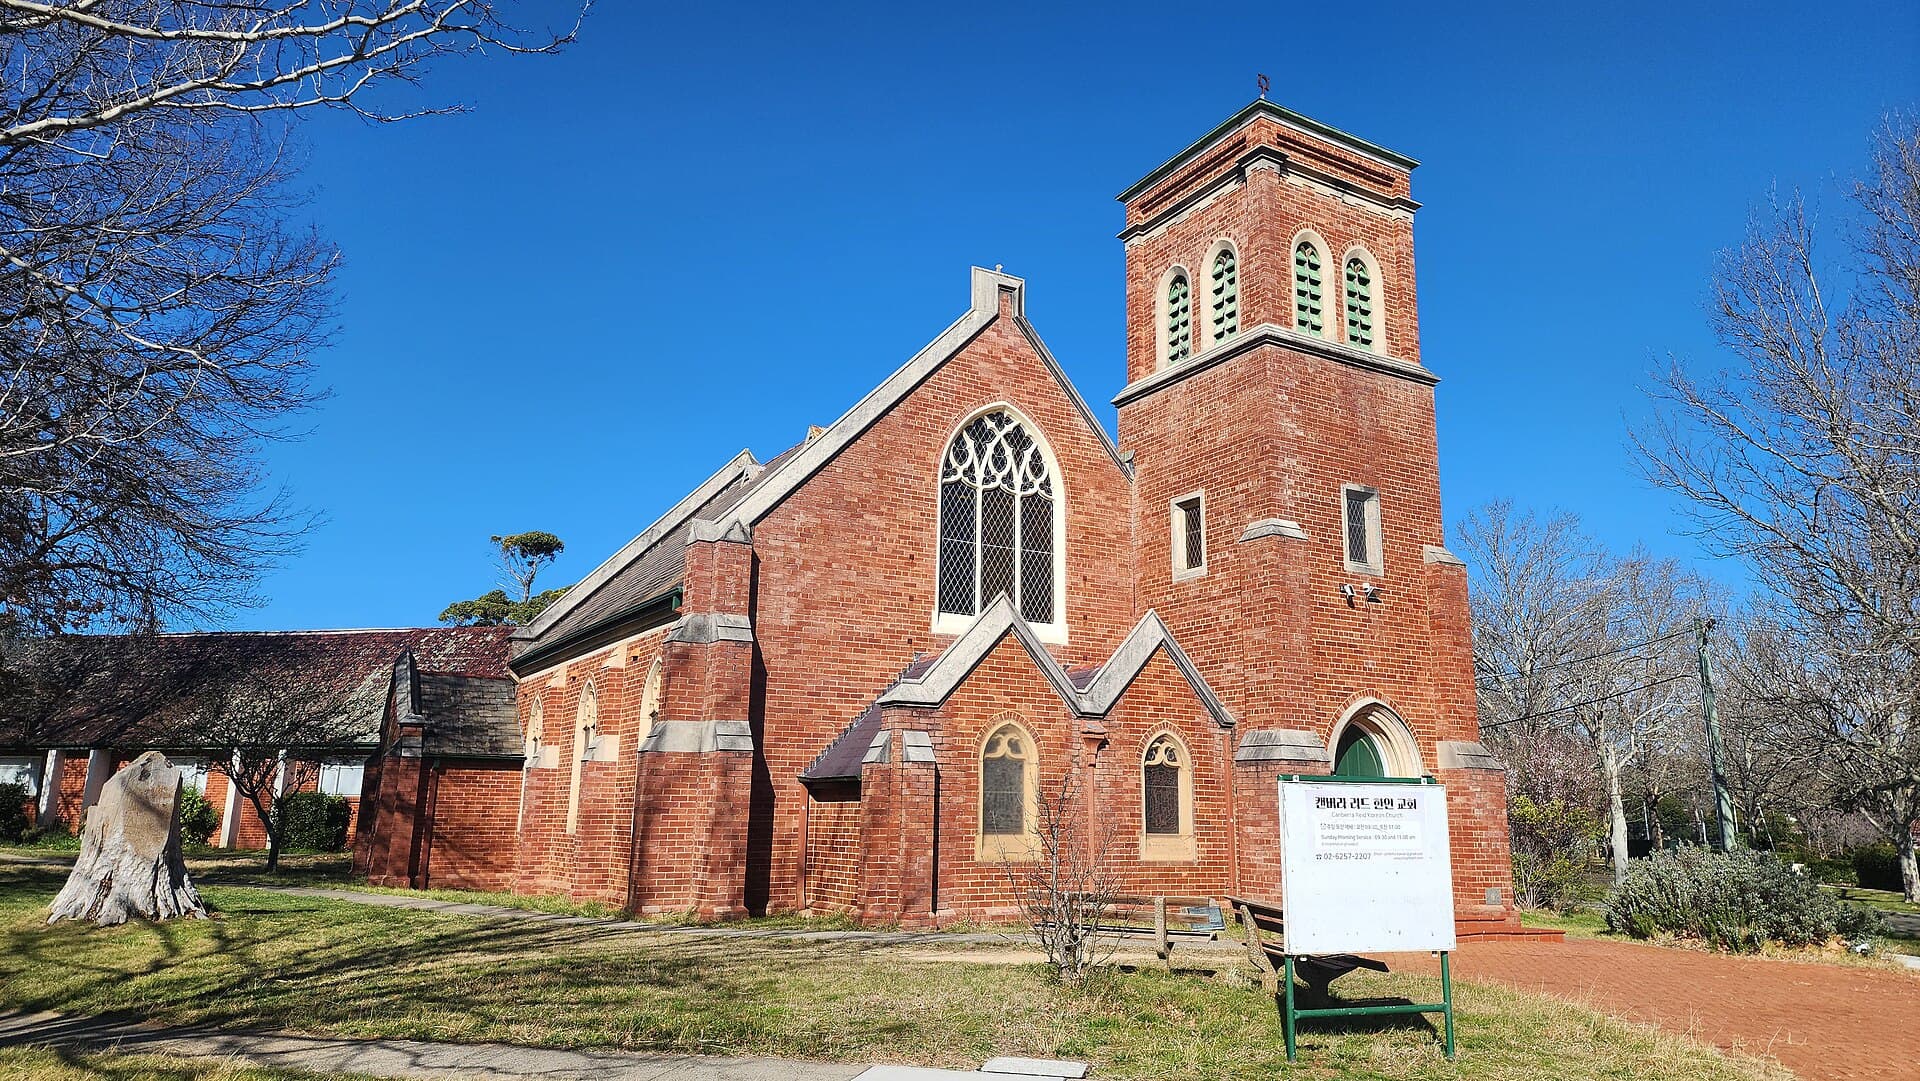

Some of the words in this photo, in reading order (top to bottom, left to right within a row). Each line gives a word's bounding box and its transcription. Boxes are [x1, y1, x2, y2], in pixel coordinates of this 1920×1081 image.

[1315, 796, 1346, 810] 캔버라
[1350, 797, 1371, 810] 리드
[1373, 797, 1394, 810] 한인
[1397, 797, 1417, 810] 교회
[1323, 852, 1371, 860] 02-6257-2207
